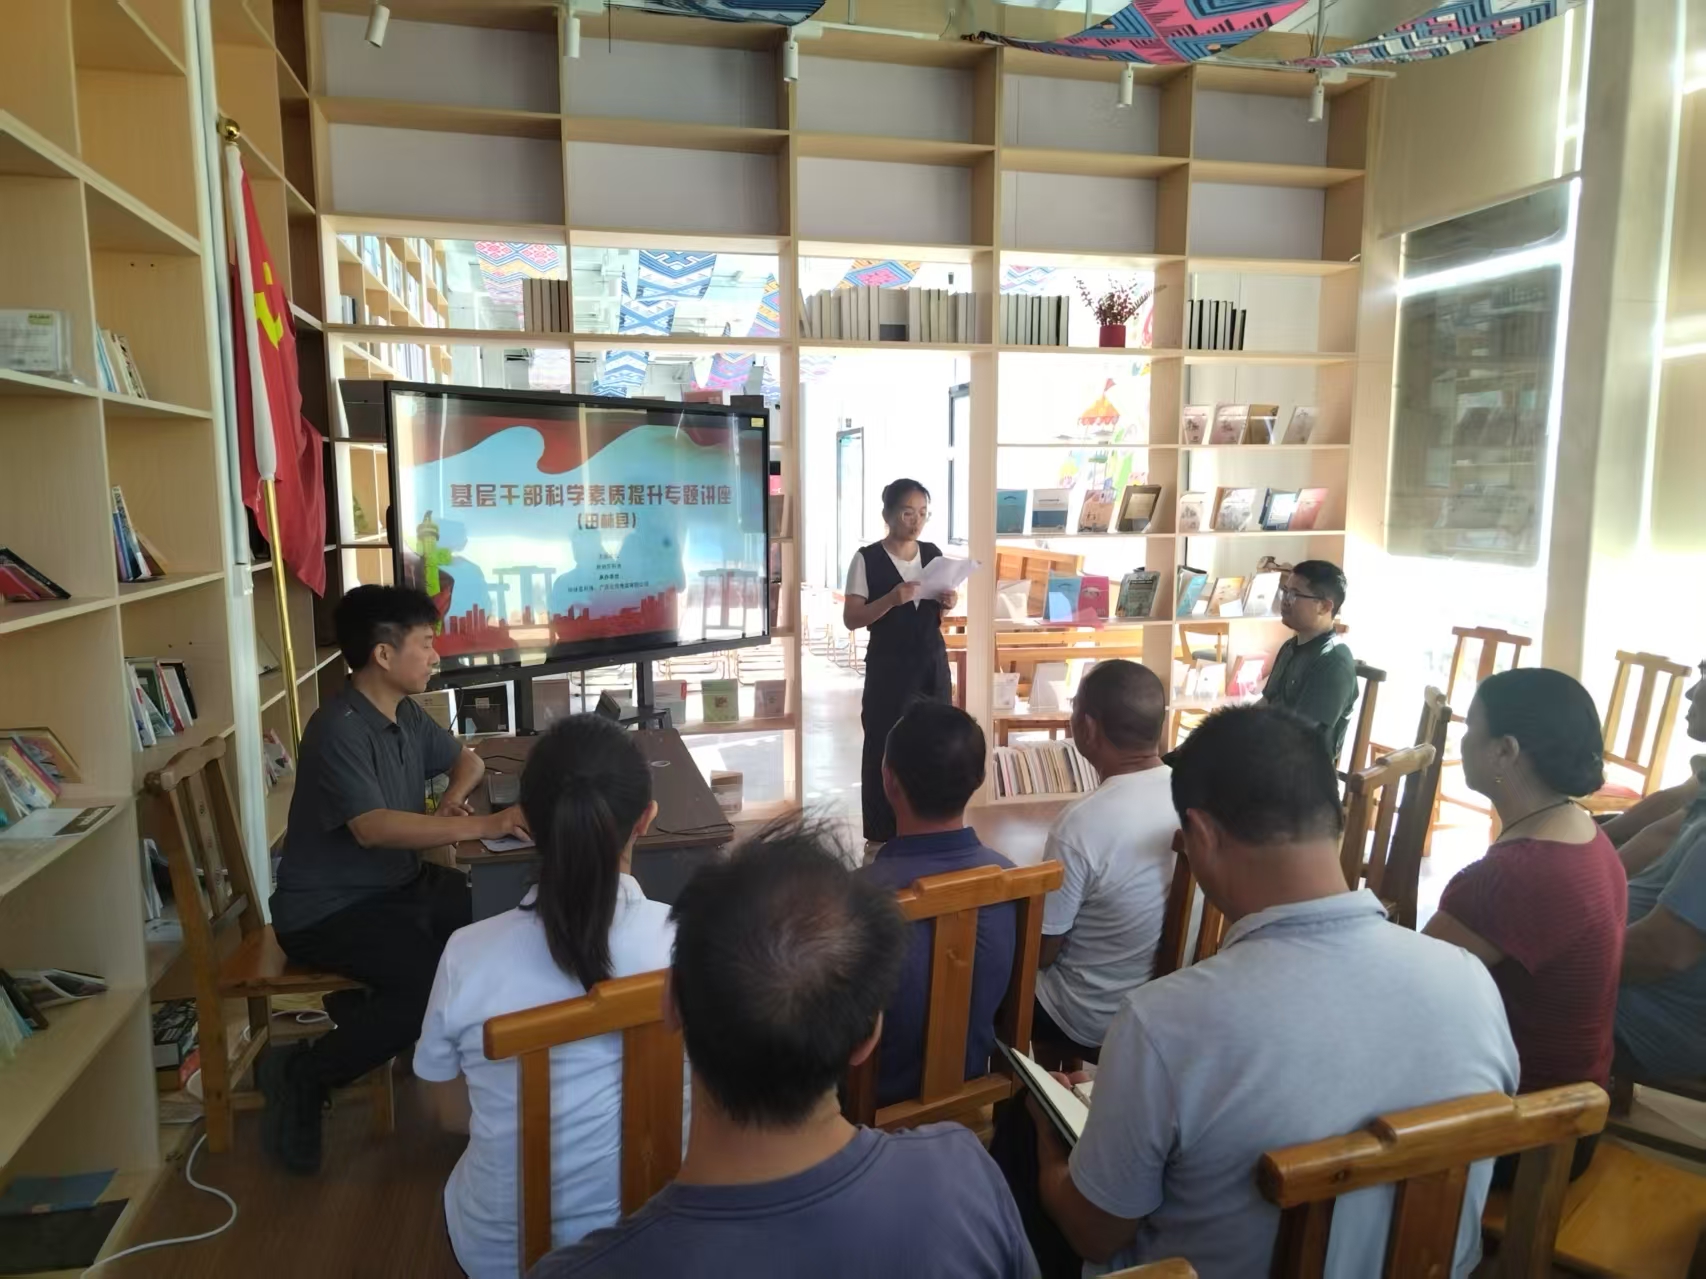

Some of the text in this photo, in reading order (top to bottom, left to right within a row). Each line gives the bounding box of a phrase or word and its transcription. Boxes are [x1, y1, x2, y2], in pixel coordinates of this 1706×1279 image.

[450, 483, 733, 508] 基层干部科学素质提升专题讲座
